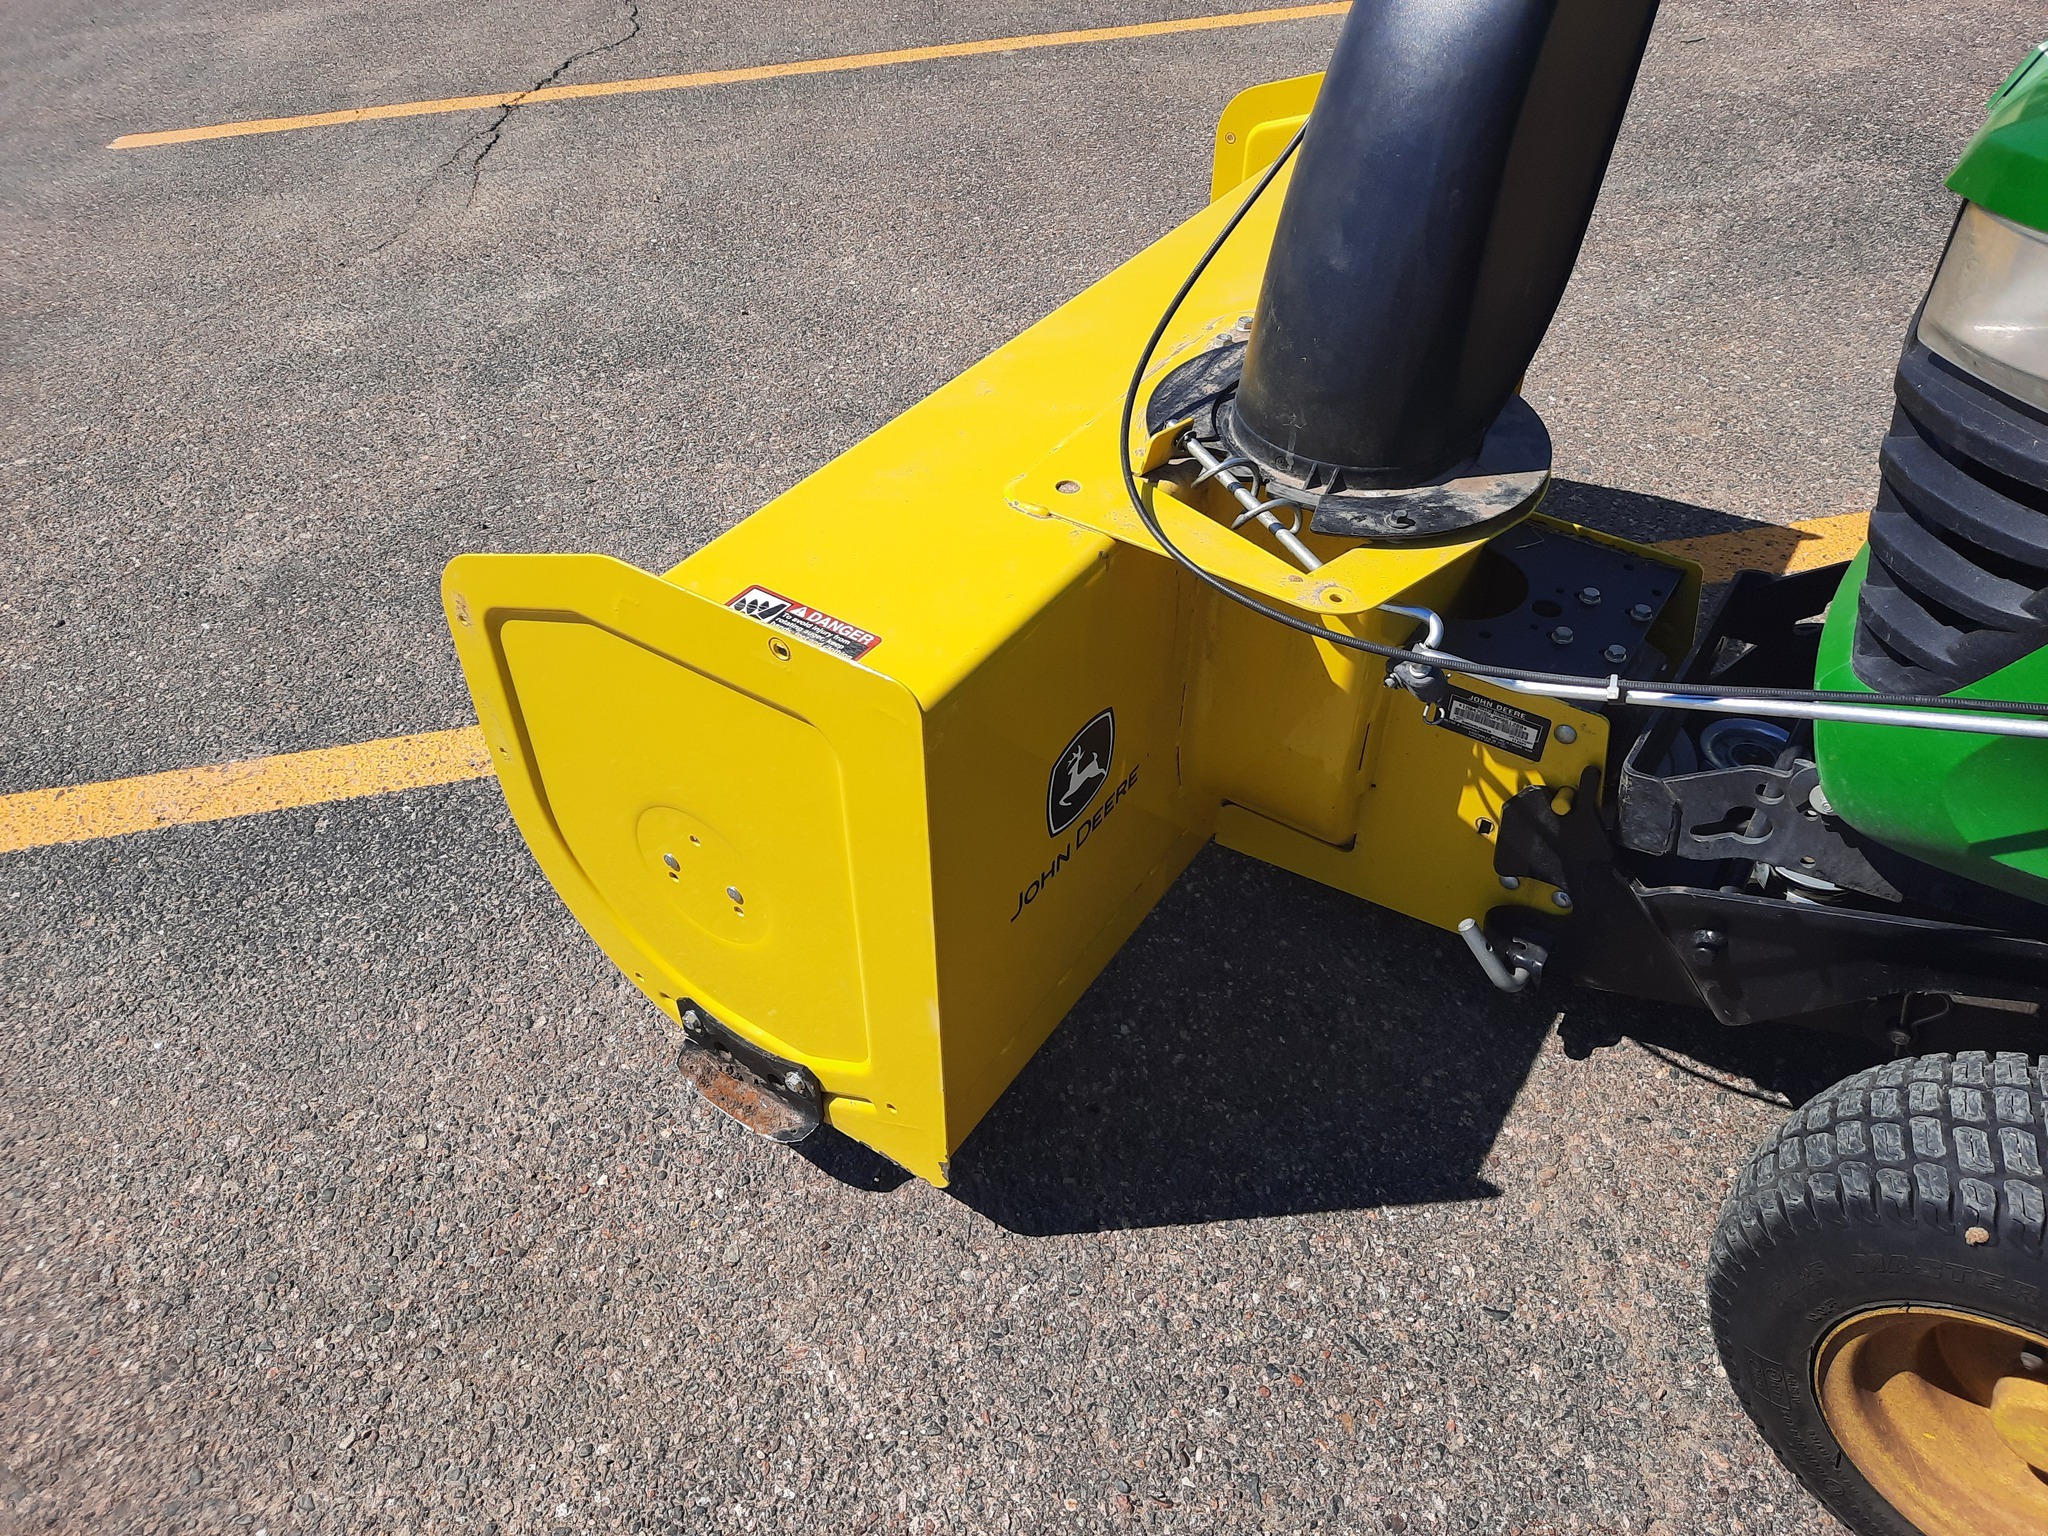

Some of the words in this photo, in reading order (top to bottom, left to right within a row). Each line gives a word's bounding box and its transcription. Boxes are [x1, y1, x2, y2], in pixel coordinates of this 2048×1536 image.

[775, 618, 804, 632] rotating
[826, 638, 845, 650] keep
[782, 612, 793, 620] To
[792, 616, 815, 629] avoid
[812, 625, 834, 638] injury
[833, 634, 851, 645] from
[806, 612, 875, 645] DANGER
[1468, 695, 1493, 709] JOHN
[1496, 704, 1527, 720] DEERE
[1010, 842, 1072, 924] JOHN
[1075, 763, 1141, 851] DEERE
